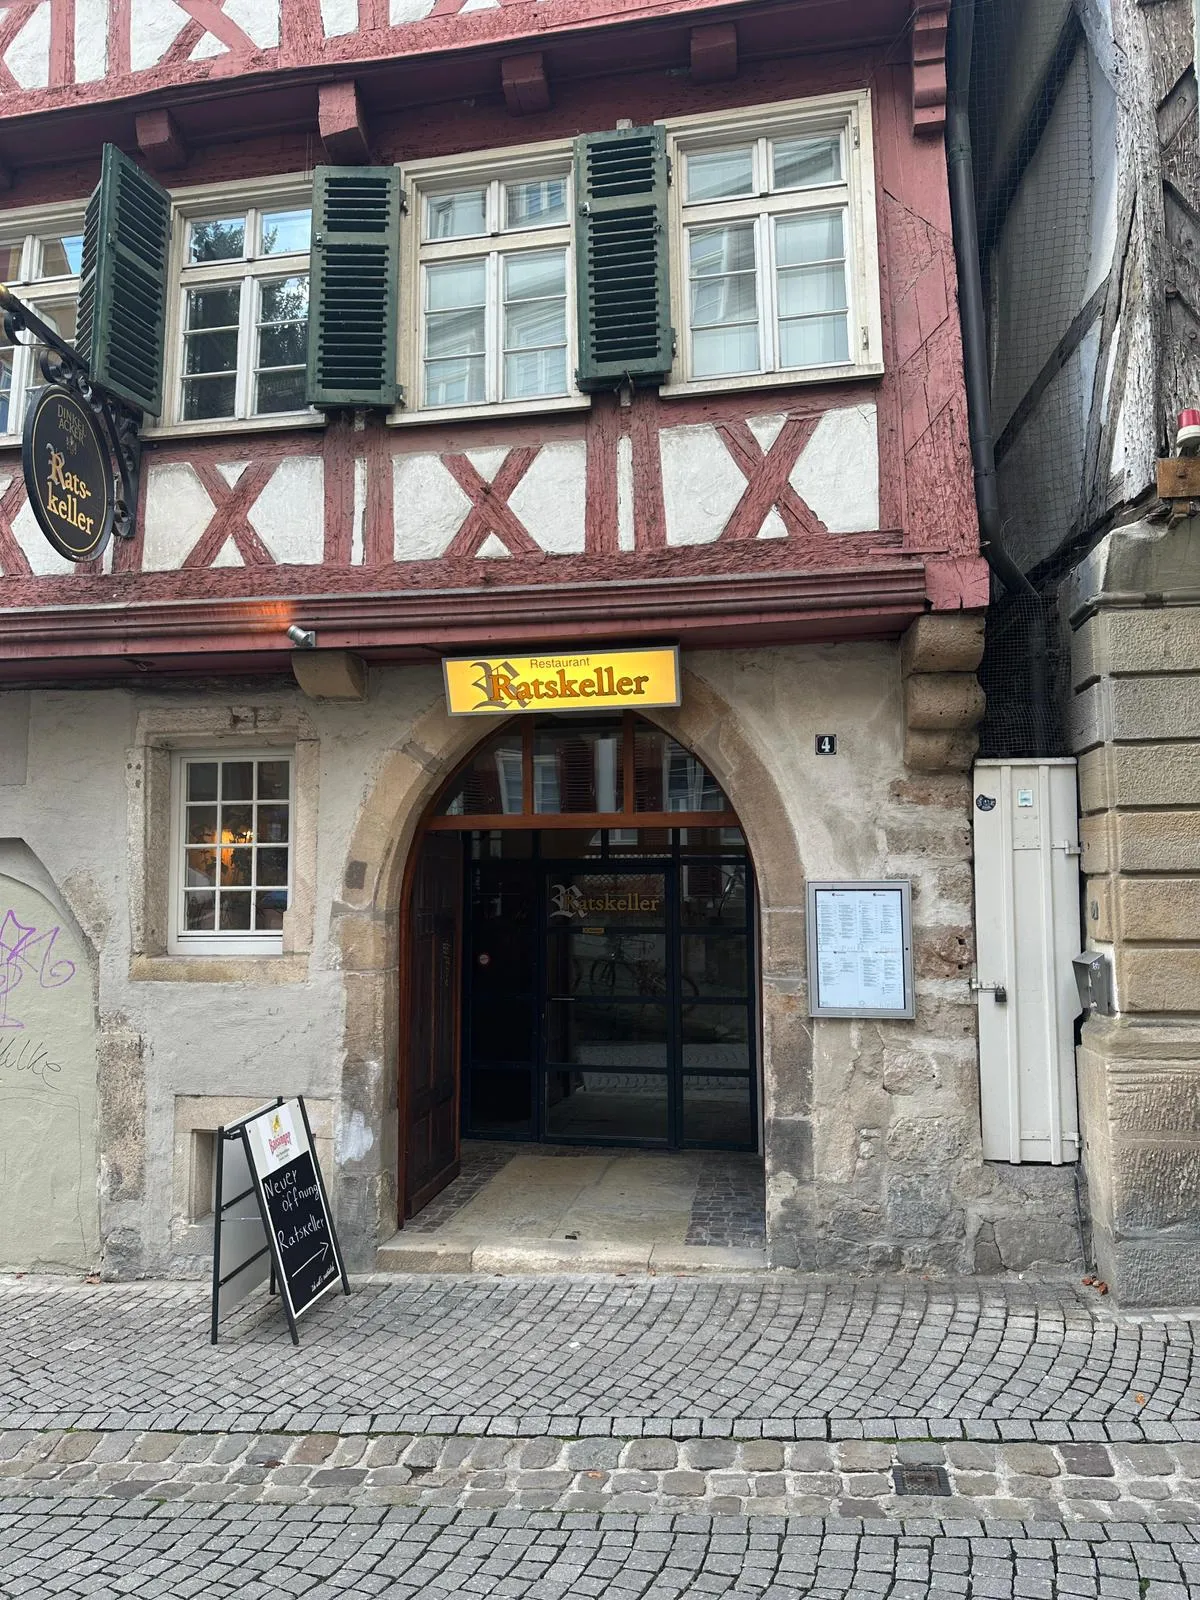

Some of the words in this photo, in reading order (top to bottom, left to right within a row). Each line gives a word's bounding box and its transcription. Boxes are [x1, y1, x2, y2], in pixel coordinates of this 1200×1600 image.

[59, 418, 84, 447] ACKER
[46, 442, 92, 499] Rats-
[46, 481, 94, 535] keller
[530, 657, 590, 669] Restaurant
[470, 661, 650, 710] Ratskeller
[821, 736, 831, 753] 4
[551, 886, 660, 917] Ratskeller
[264, 1169, 297, 1200] Neuer
